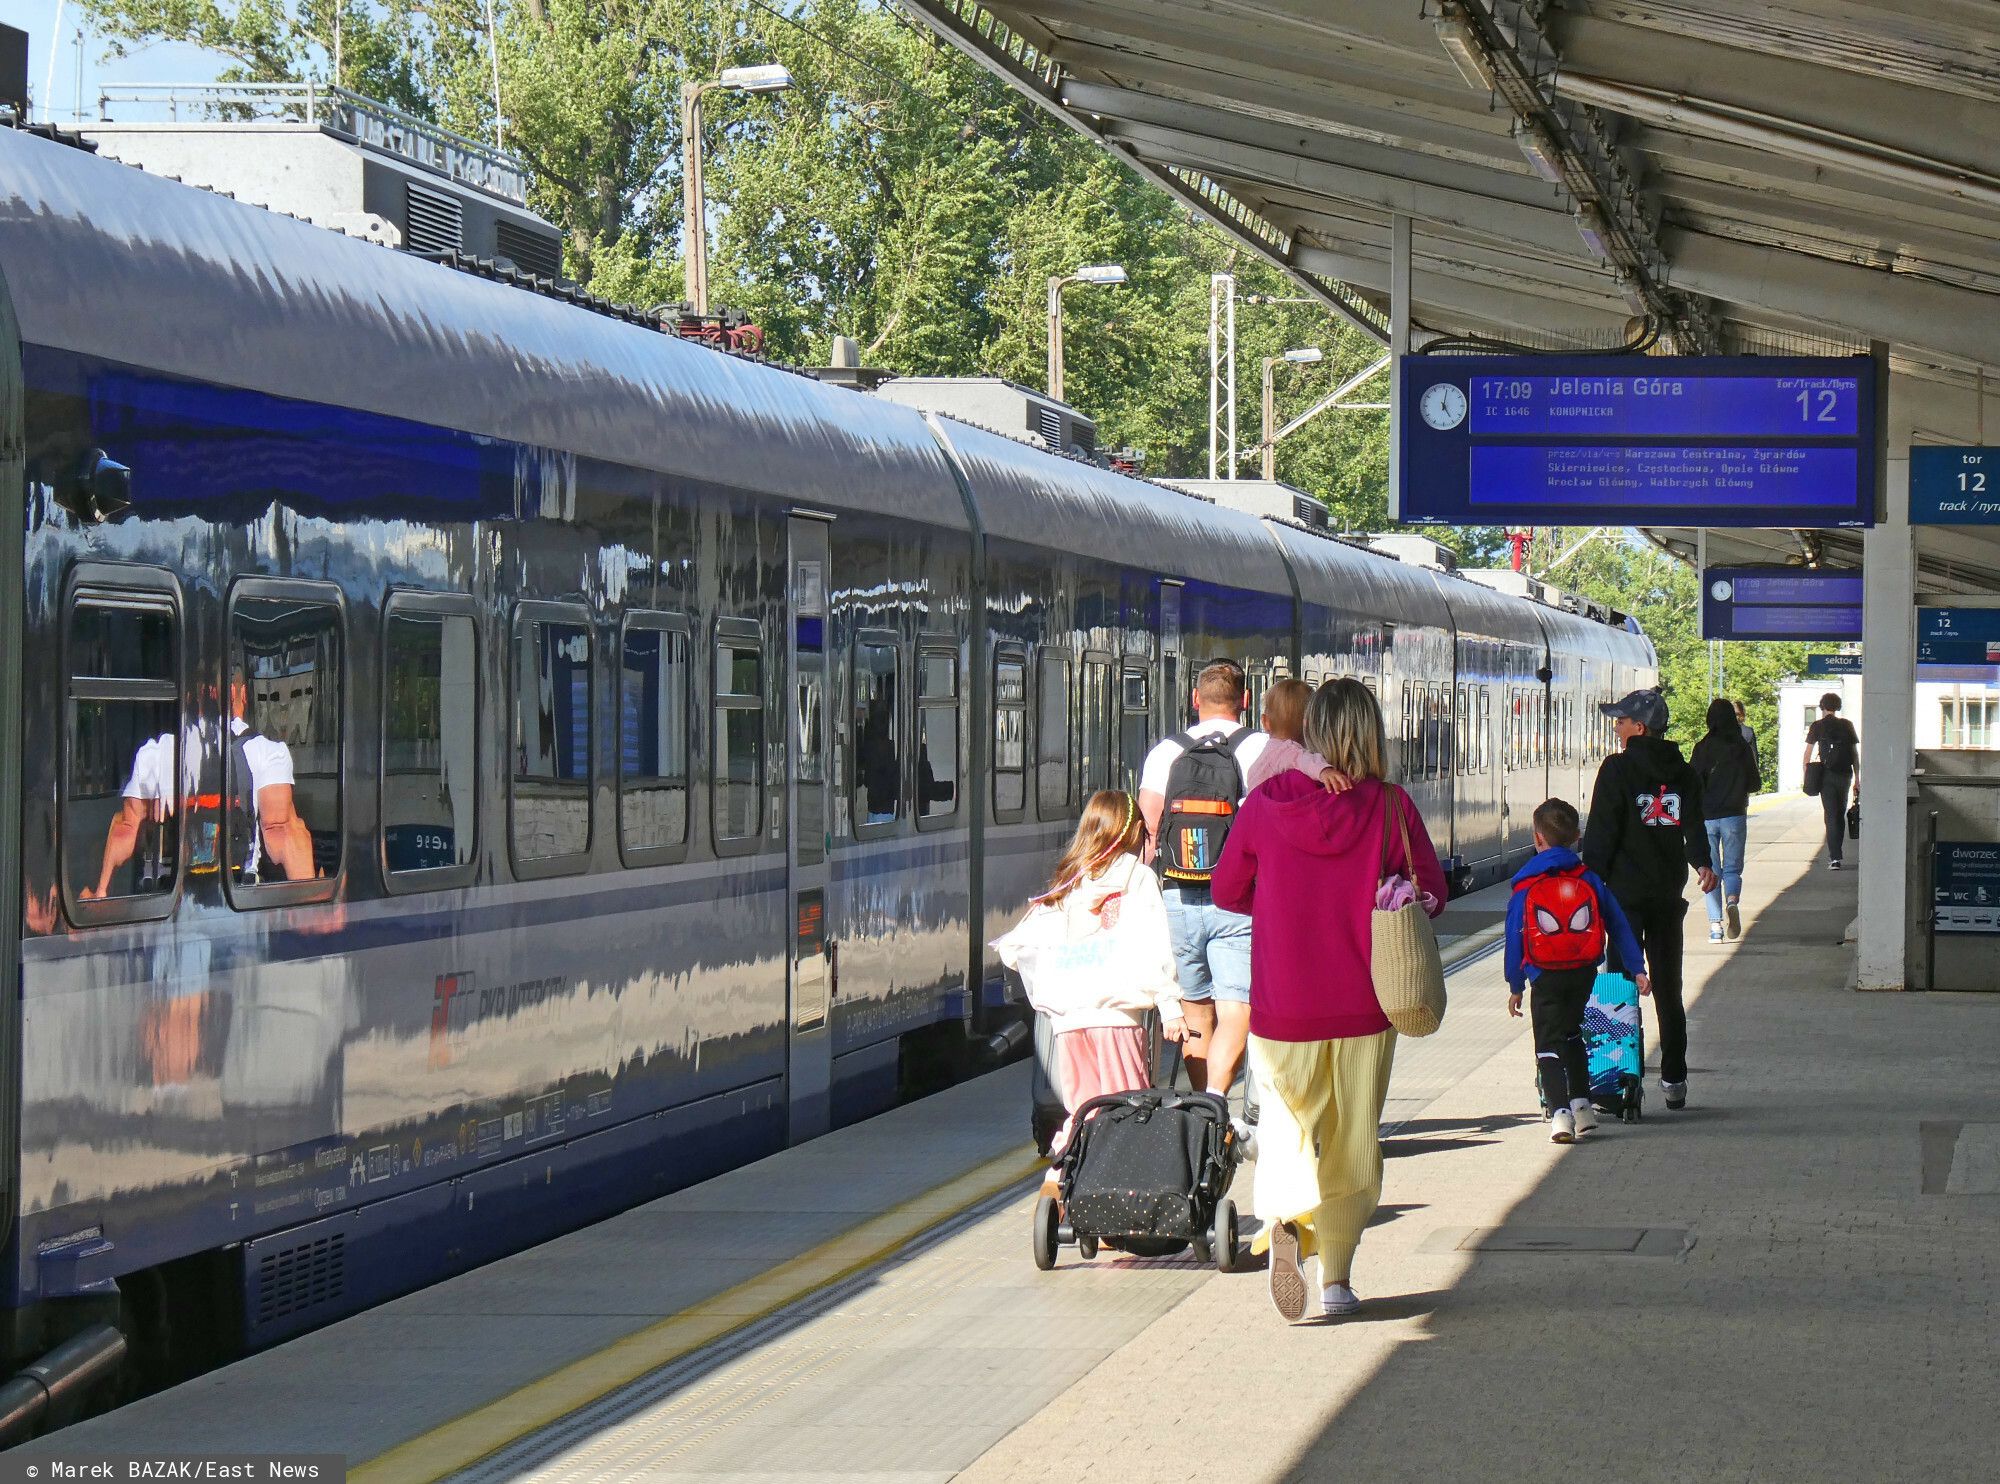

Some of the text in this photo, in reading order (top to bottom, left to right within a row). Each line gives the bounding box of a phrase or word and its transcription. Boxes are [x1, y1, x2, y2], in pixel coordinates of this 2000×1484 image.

[1483, 378, 1683, 400] 17:09 Jelenia Góra
[1796, 389, 1837, 422] 12
[1486, 406, 1614, 417] IC 1646 KONOPNICKA
[1625, 450, 1676, 459] Warszawa
[1682, 449, 1747, 461] Centralna,
[1962, 455, 1983, 464] tor
[1548, 463, 1799, 475] Skierniewice, Częstochowa, Opole Główne
[1548, 478, 1754, 489] Wrocław Główny, Wałbrzych Główny
[1957, 472, 1986, 491] 12
[1939, 500, 1968, 511] track
[1978, 503, 2000, 514] пут
[1937, 618, 1951, 628] 12
[1921, 647, 1931, 655] 12
[1825, 655, 1853, 665] sektor
[1636, 793, 1681, 827] 23
[1952, 848, 1998, 859] dworzec
[1953, 892, 1969, 901] wc
